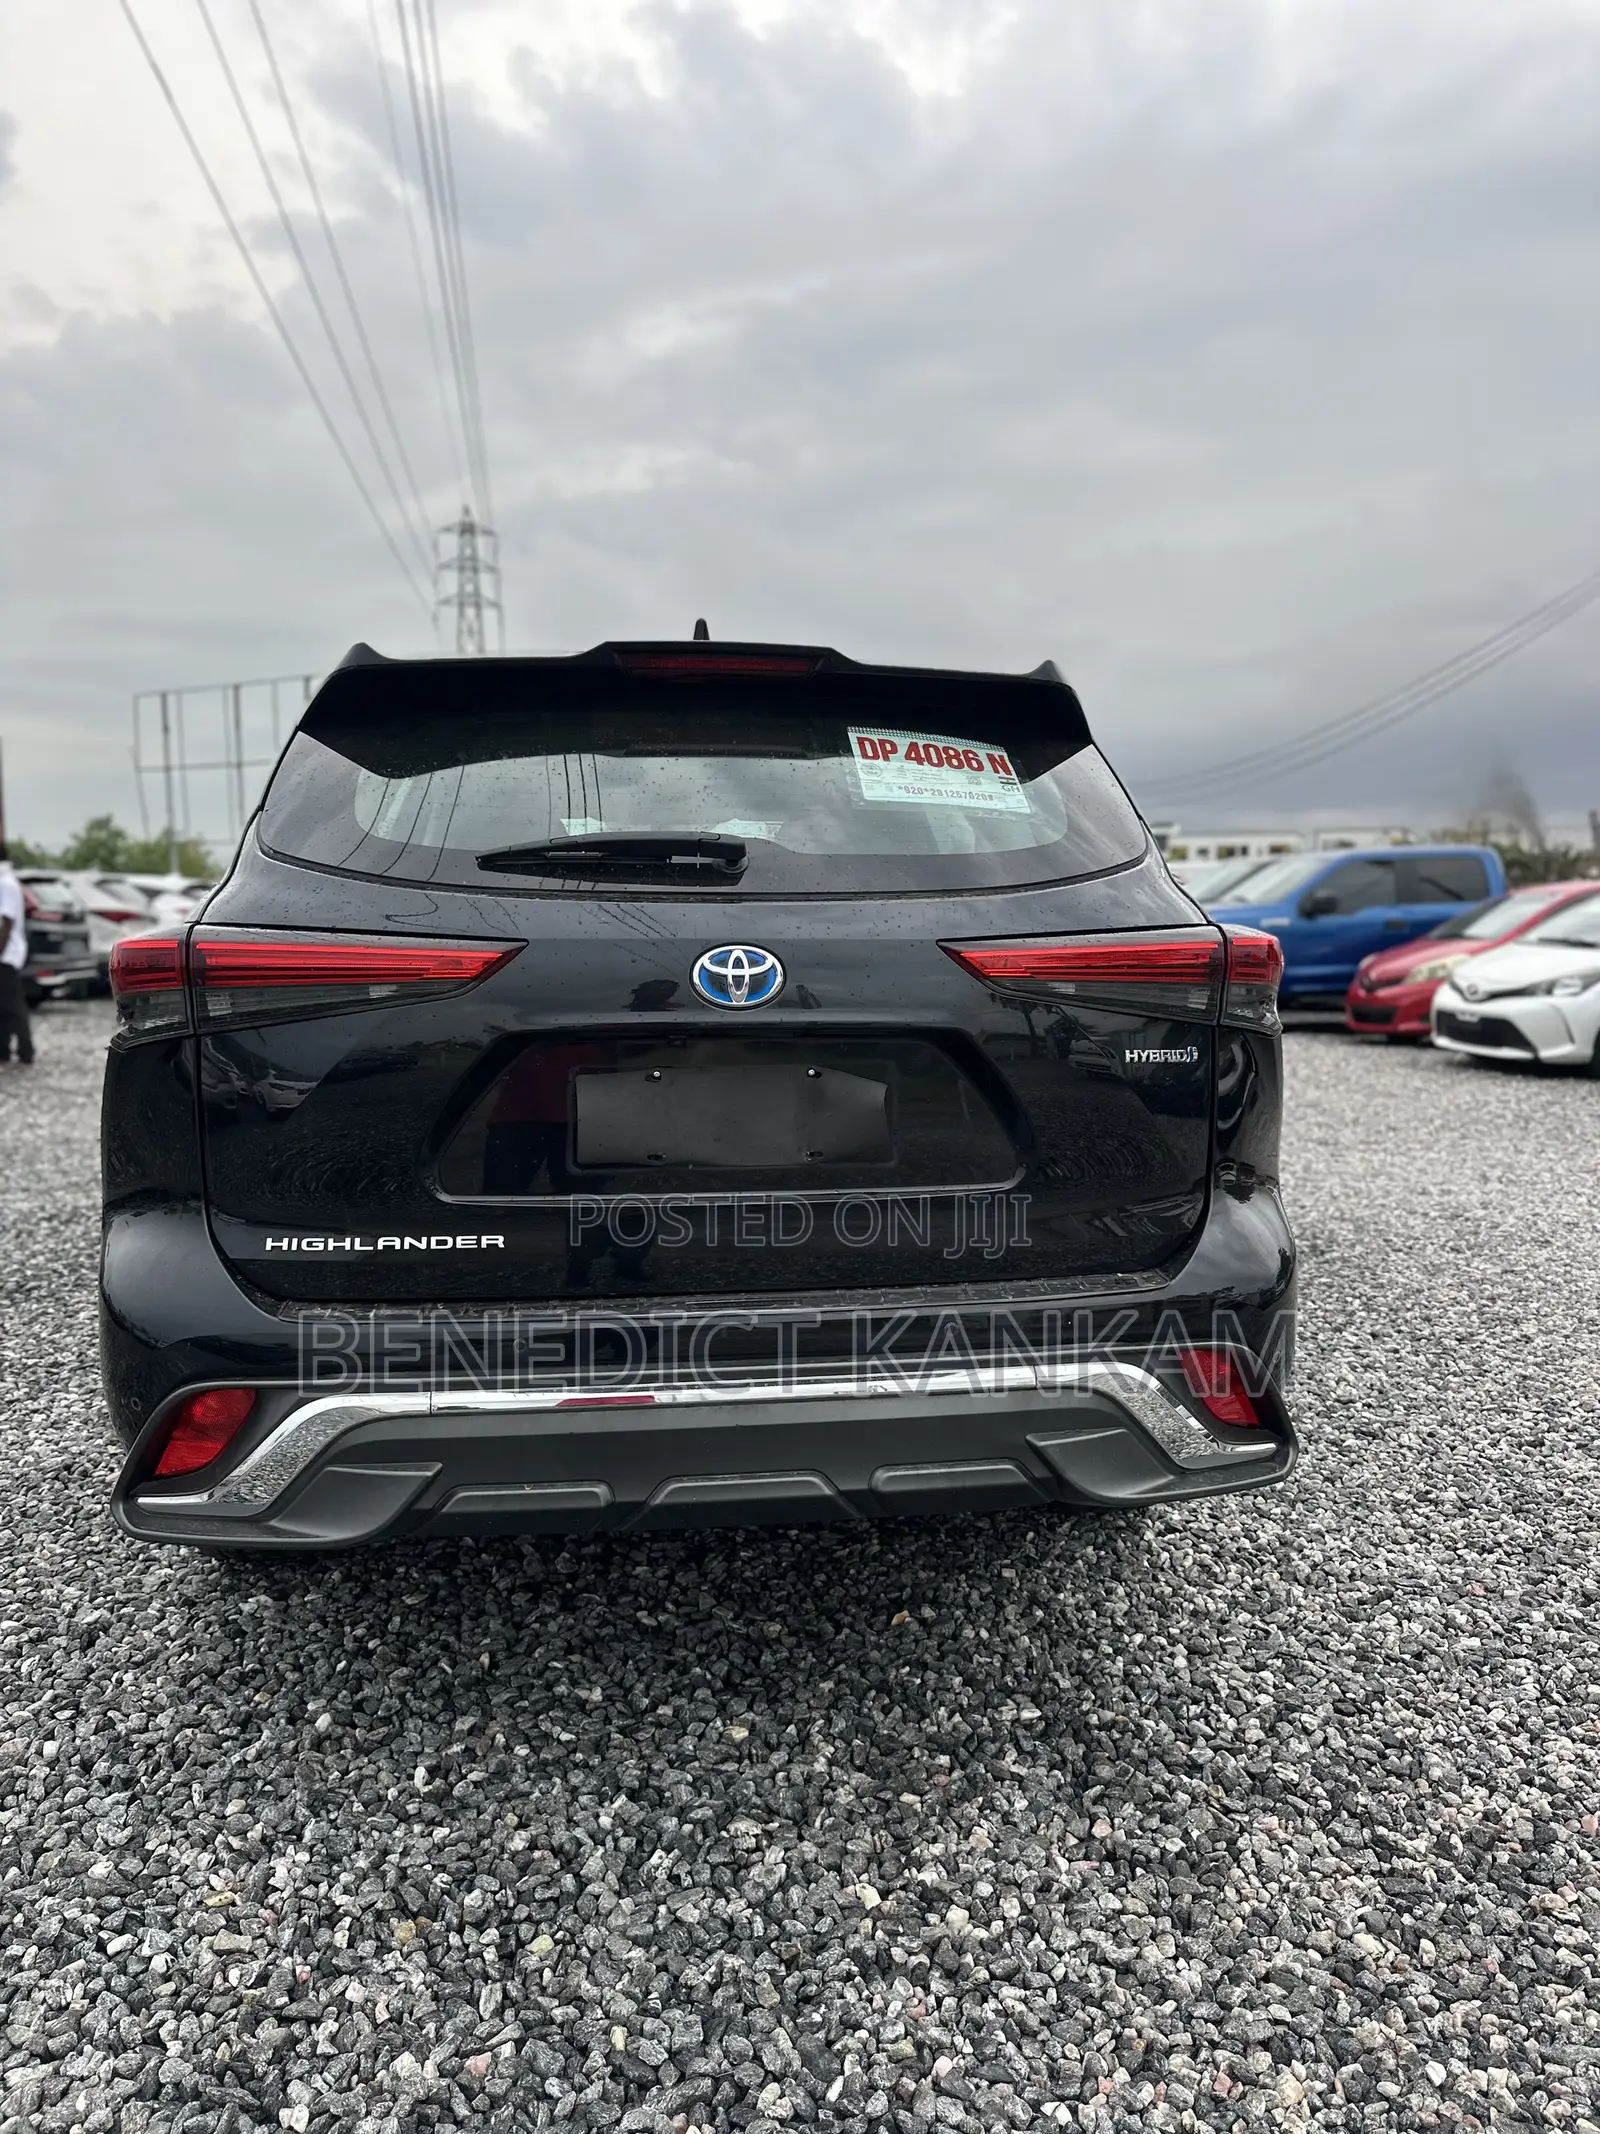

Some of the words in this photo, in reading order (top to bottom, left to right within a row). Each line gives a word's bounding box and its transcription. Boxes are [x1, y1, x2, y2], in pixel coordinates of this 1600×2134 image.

[856, 736, 898, 762] DP
[904, 741, 984, 772] 4086
[986, 752, 1013, 776] N
[1001, 784, 1021, 793] GH
[1125, 1048, 1188, 1063] HYBRID
[265, 1234, 505, 1251] HIGHLANDER
